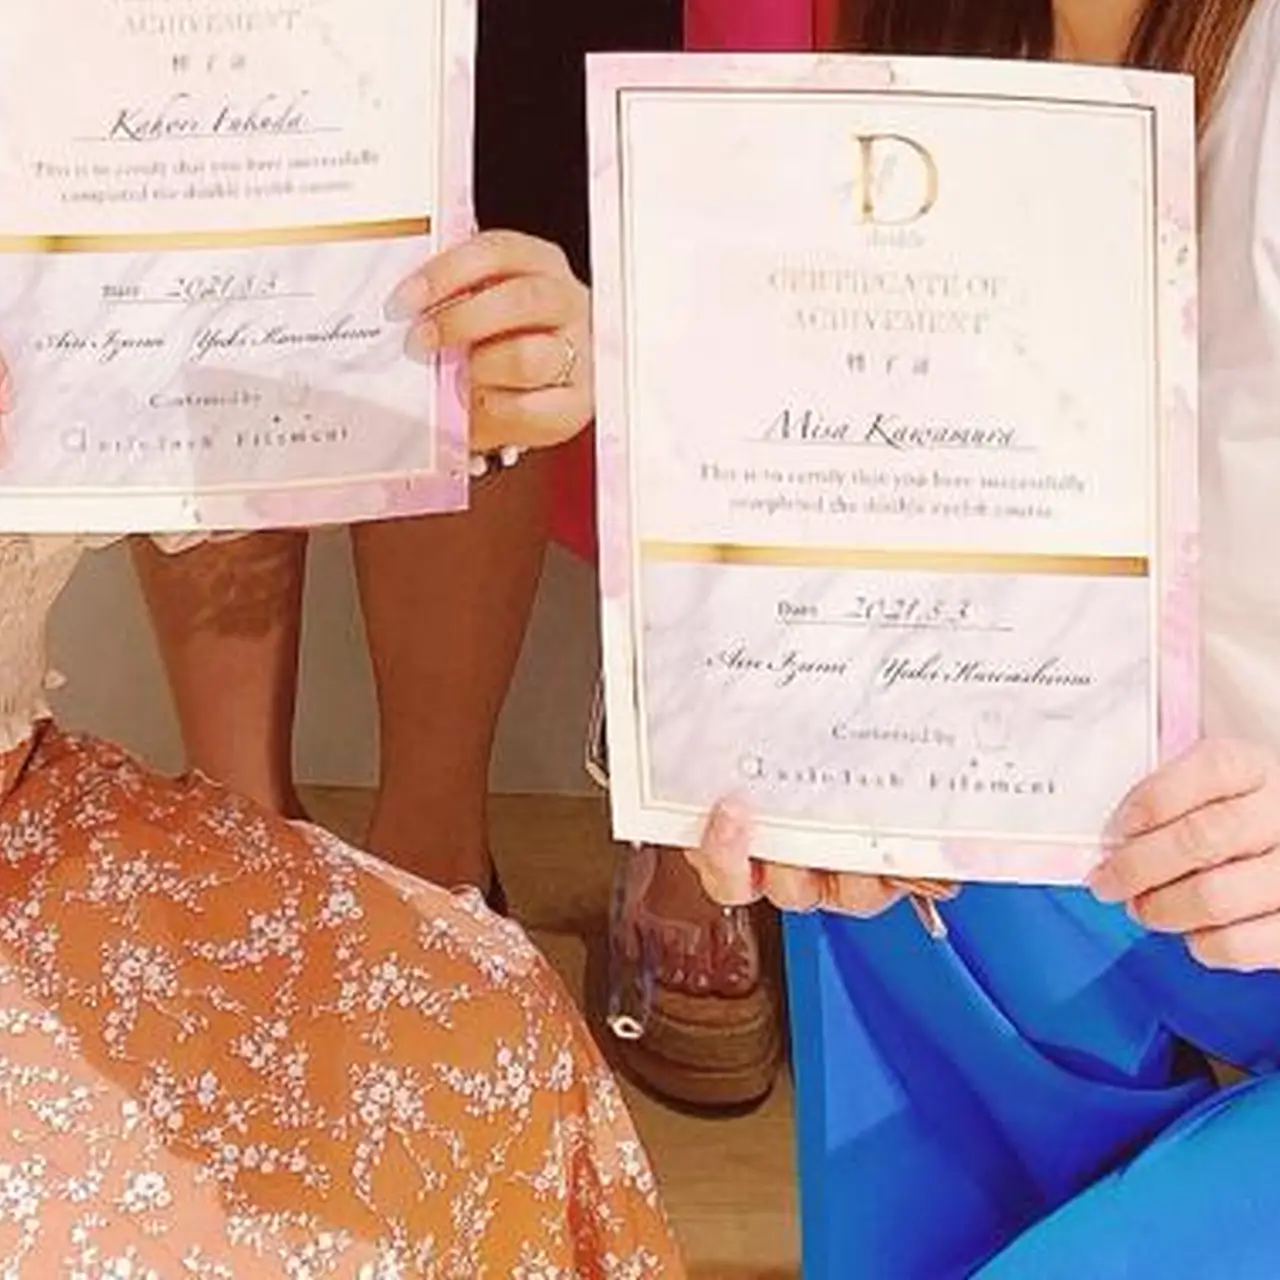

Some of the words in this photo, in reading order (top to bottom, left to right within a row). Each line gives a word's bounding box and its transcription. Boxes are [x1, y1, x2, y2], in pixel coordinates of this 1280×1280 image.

[174, 157, 205, 173] that
[854, 132, 937, 225] D
[764, 267, 955, 298] CERTIFICATE
[964, 273, 1005, 299] OF
[762, 408, 849, 441] Misa
[864, 412, 1016, 454] Kawamura
[695, 463, 736, 481] This
[742, 466, 755, 481] is
[762, 467, 781, 483] to
[850, 468, 885, 486] that
[893, 474, 926, 491] you
[828, 496, 856, 513] the
[776, 601, 818, 617] Date
